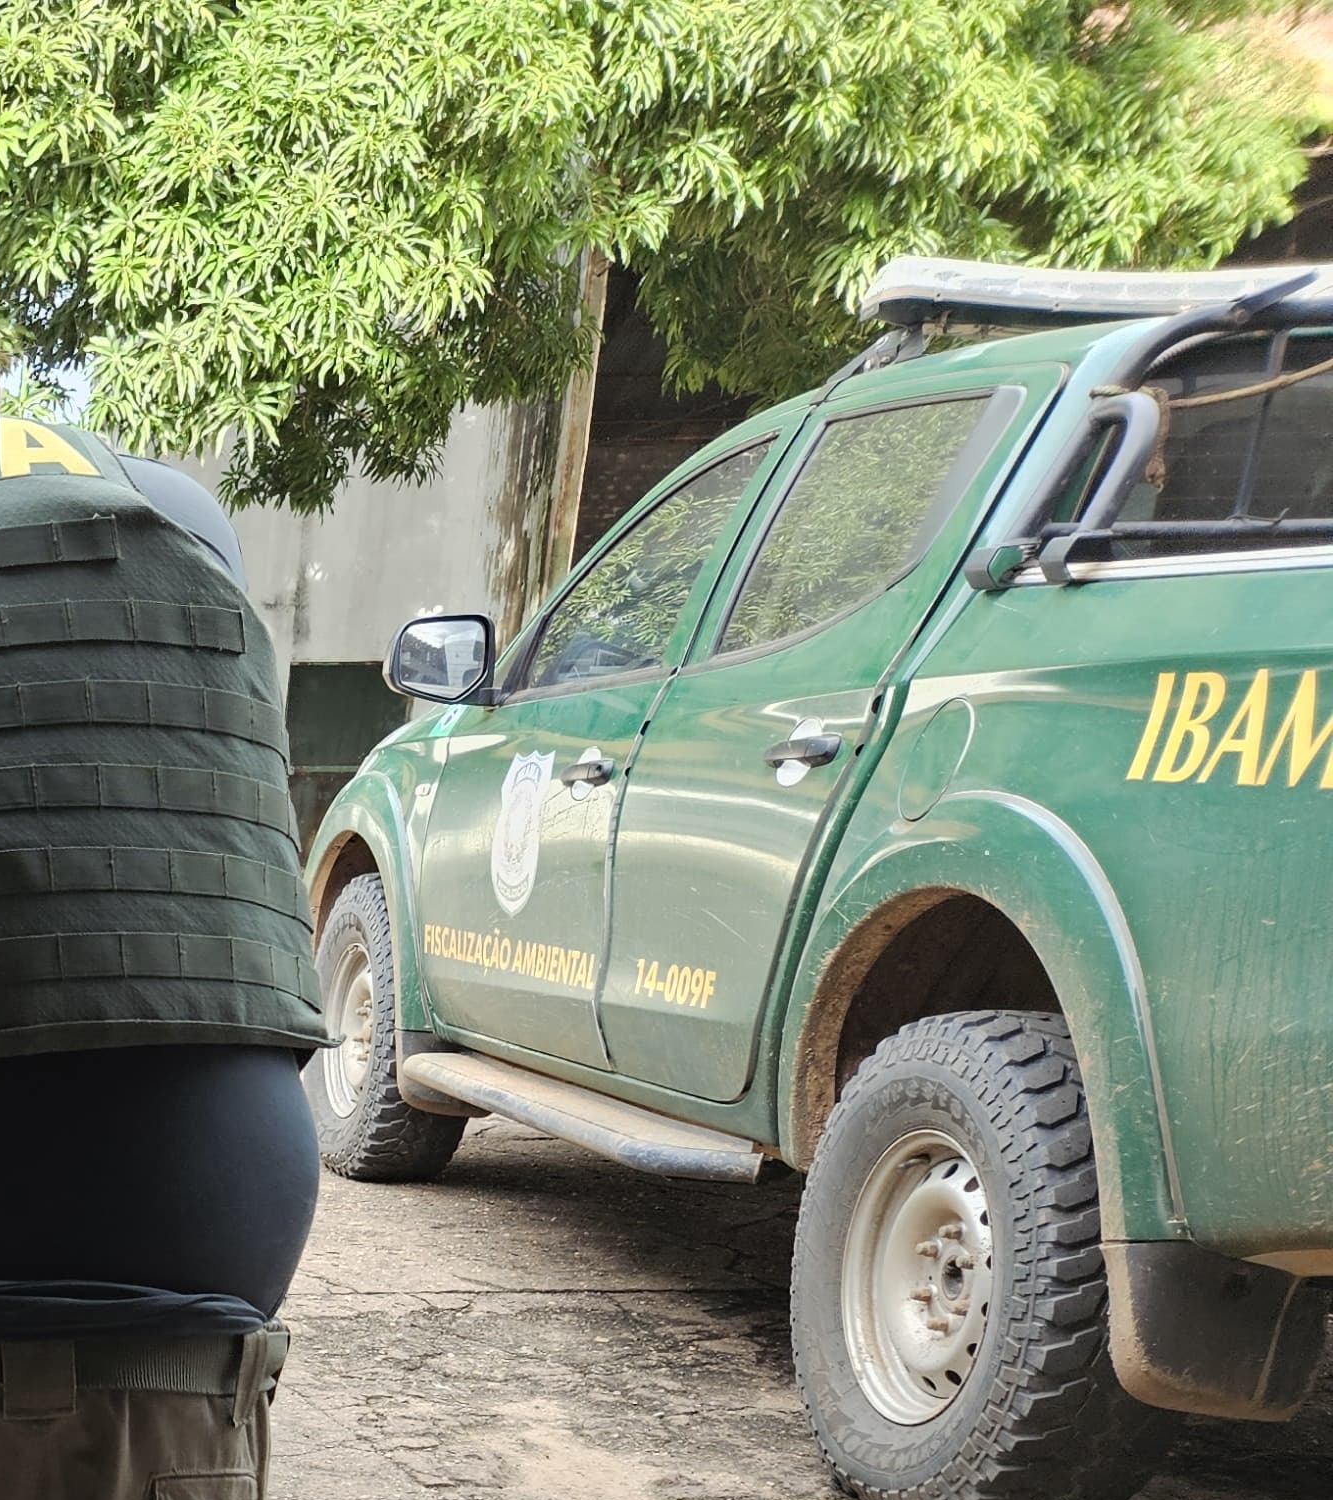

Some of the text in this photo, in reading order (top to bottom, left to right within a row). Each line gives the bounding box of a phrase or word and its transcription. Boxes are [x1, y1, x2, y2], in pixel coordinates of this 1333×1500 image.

[424, 924, 597, 990] FISCALIZAÇÃO AMBIENTAL
[634, 958, 717, 1009] 14-009F
